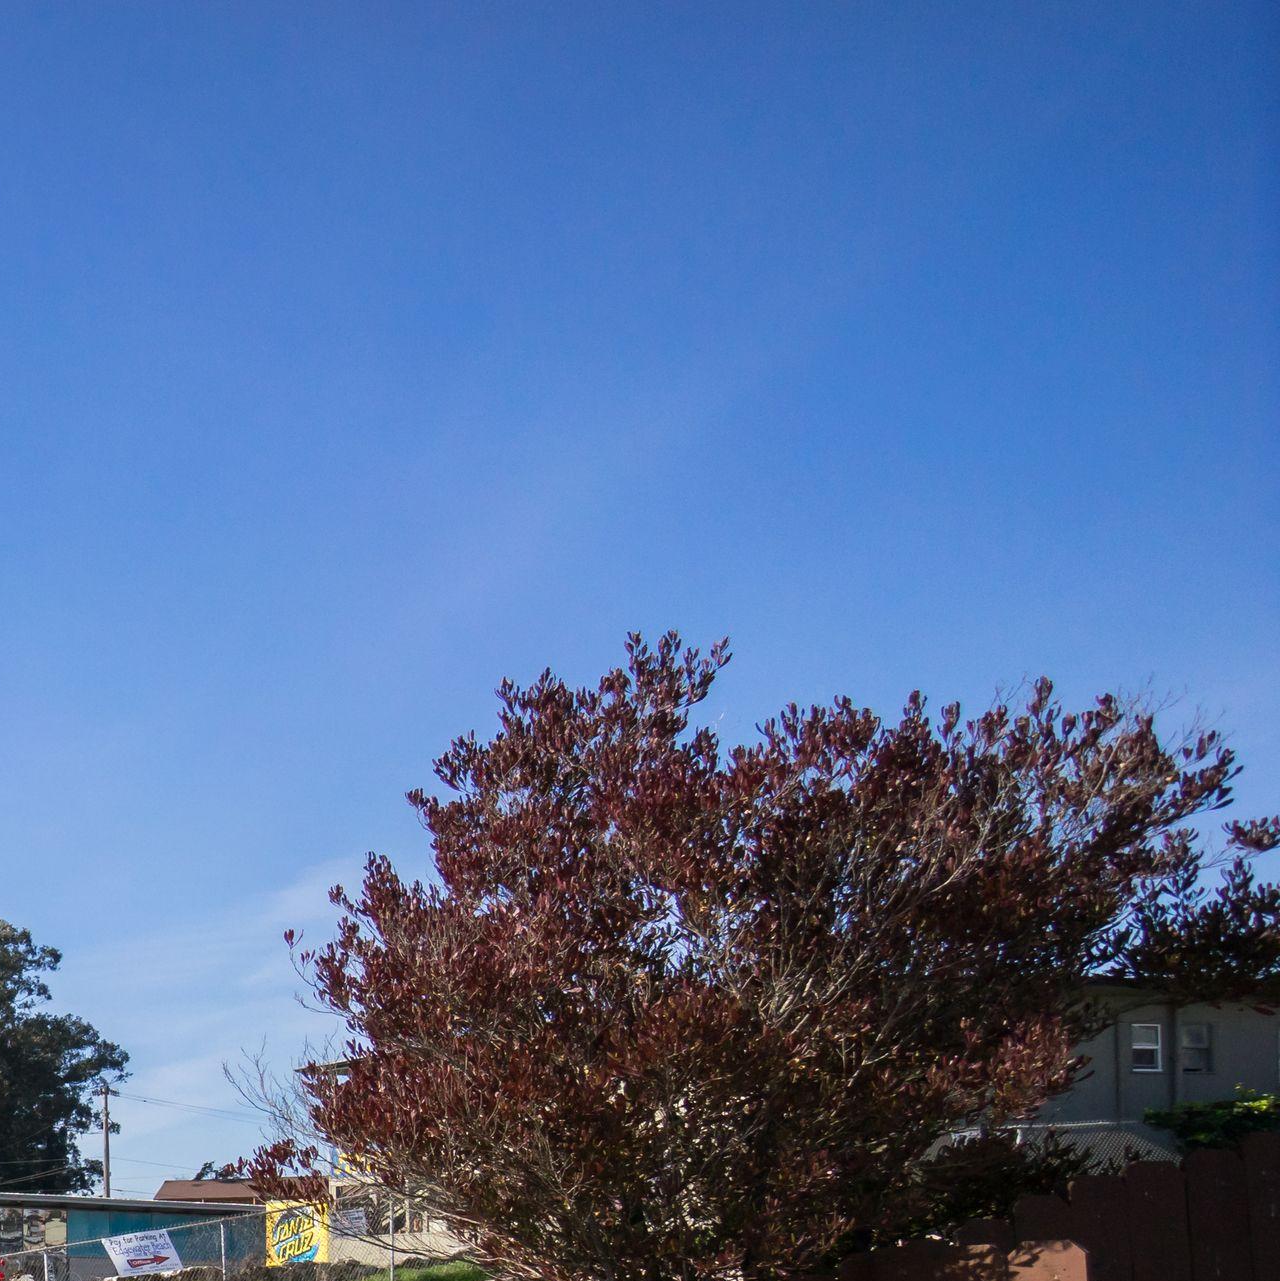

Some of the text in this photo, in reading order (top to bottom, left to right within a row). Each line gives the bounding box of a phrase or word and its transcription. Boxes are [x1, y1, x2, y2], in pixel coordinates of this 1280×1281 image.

[134, 1233, 158, 1242] Parking
[271, 1210, 314, 1246] SANTA
[279, 1231, 313, 1262] CRUZ
